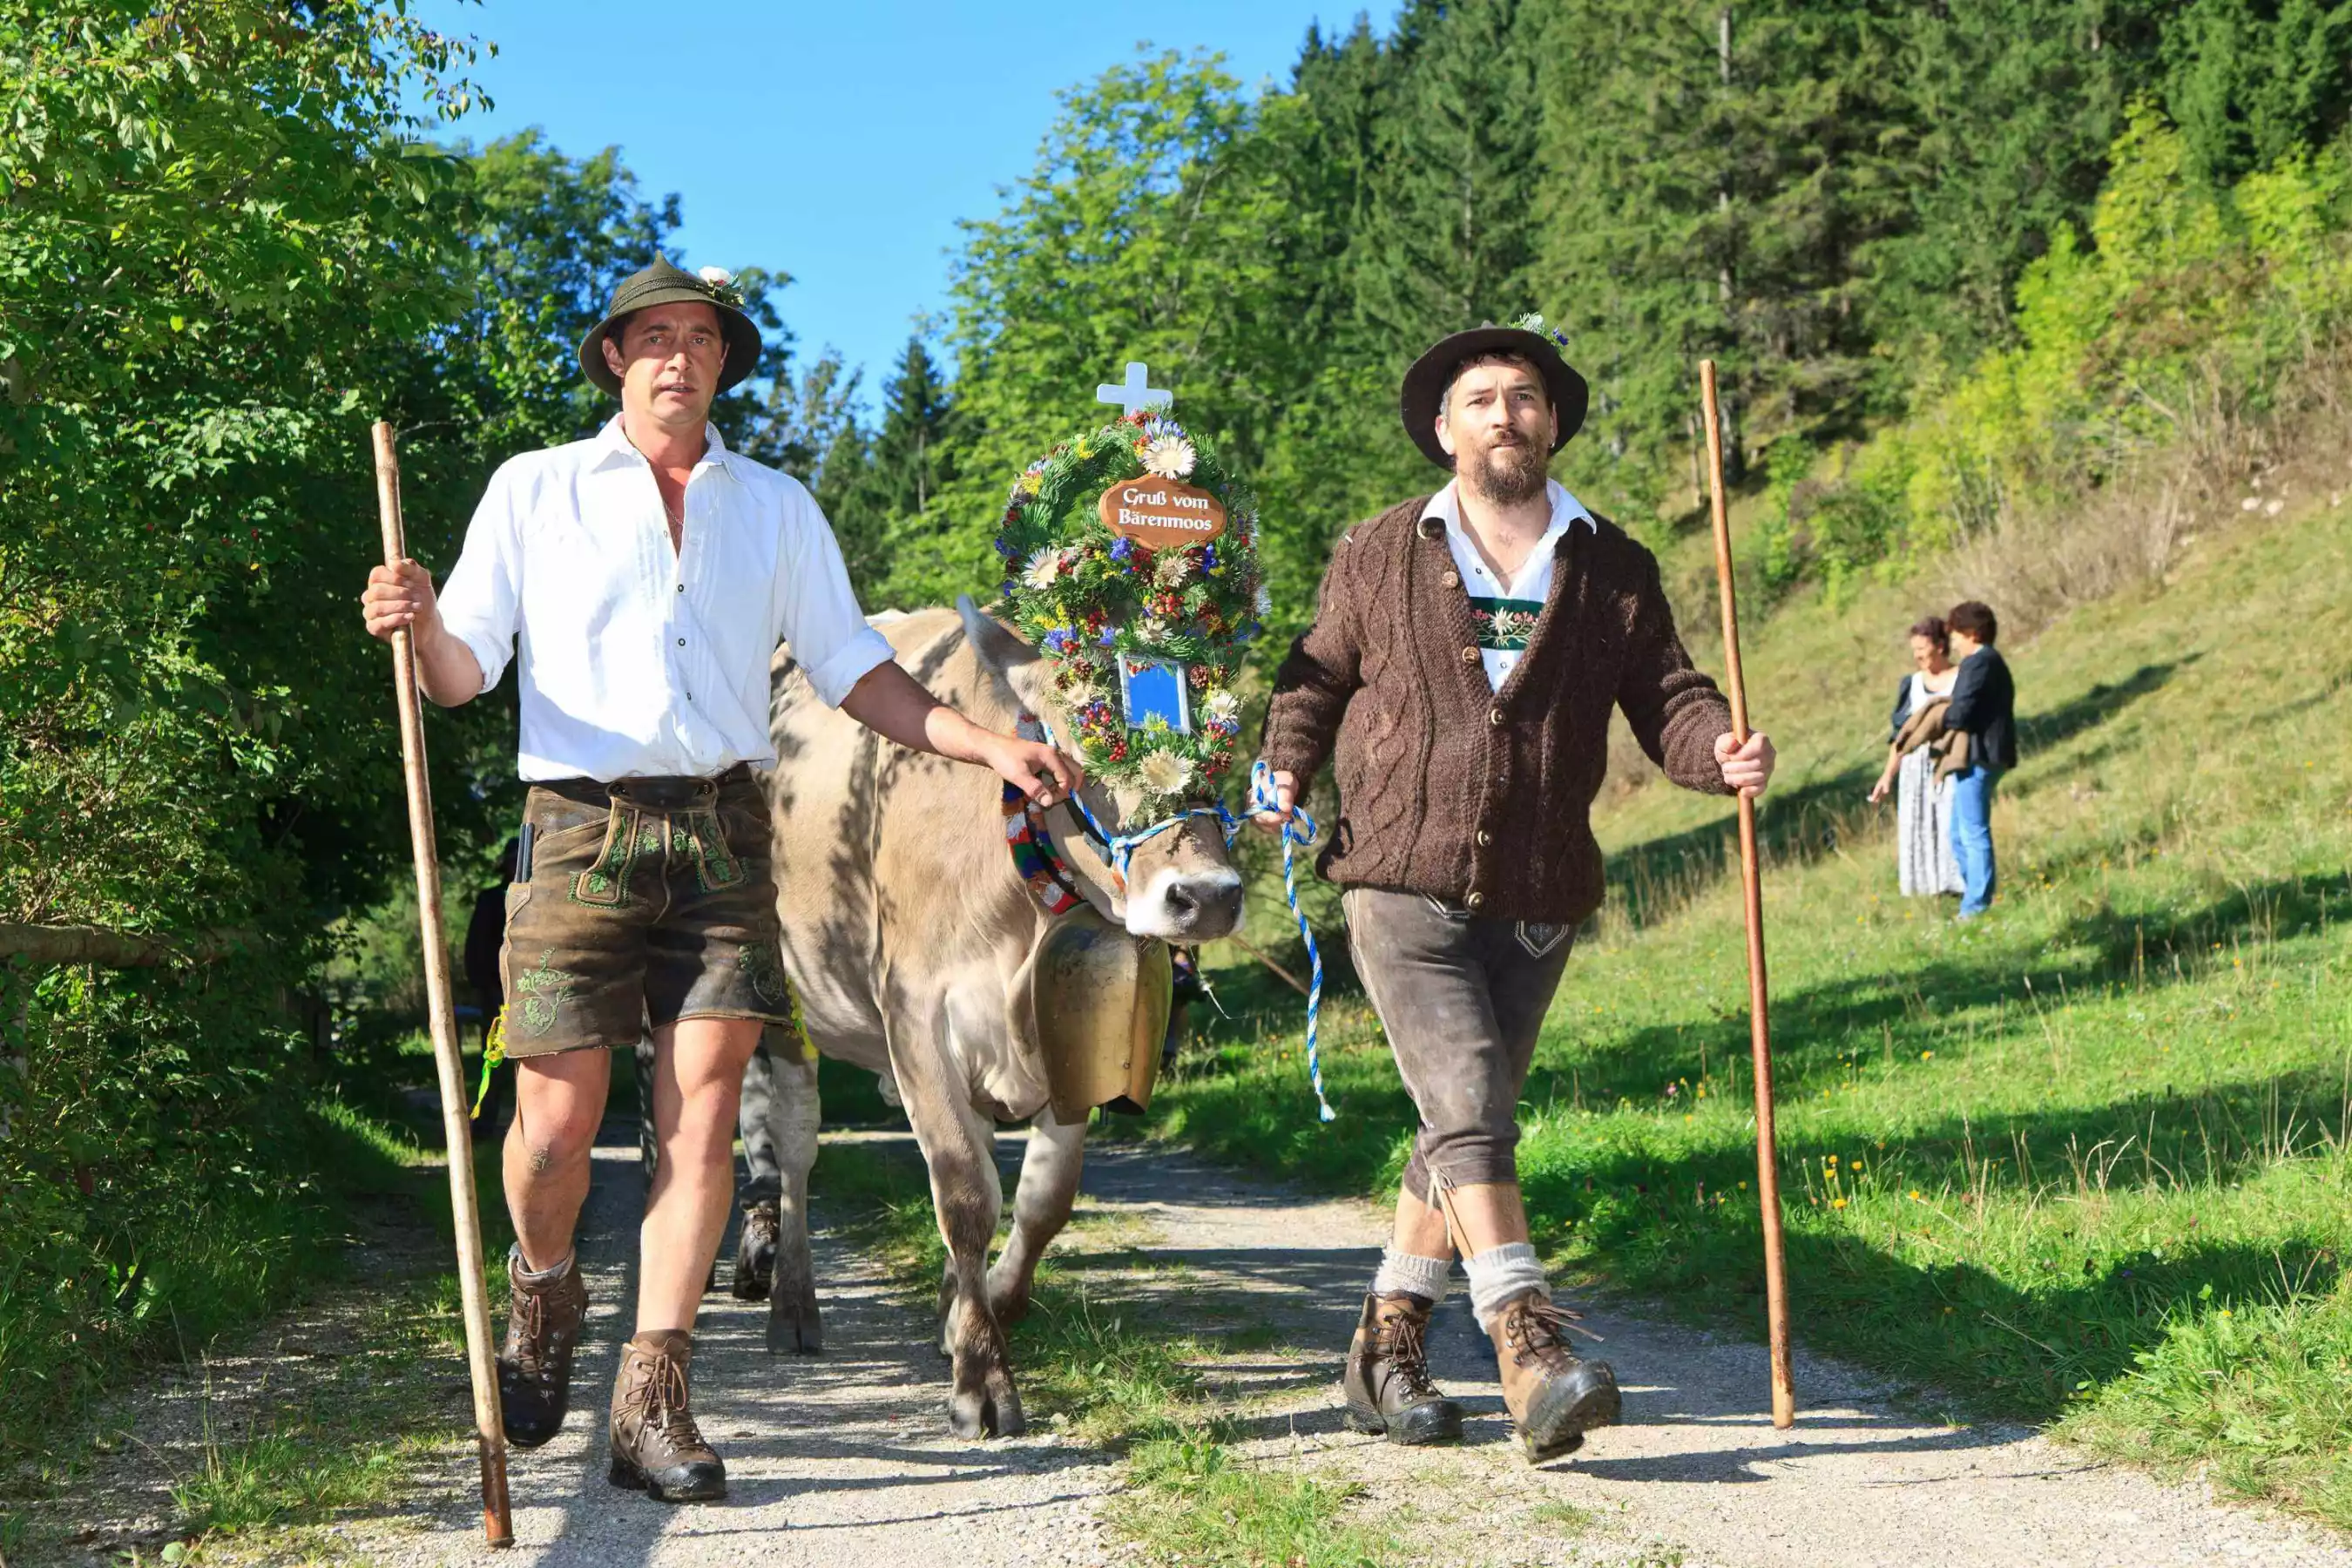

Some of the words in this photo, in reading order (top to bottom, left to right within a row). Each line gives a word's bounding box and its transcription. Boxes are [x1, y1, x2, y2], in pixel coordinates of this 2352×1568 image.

[1123, 488, 1166, 506] Gruß
[1172, 495, 1209, 510] vom
[1118, 508, 1213, 531] Bärenmoos
